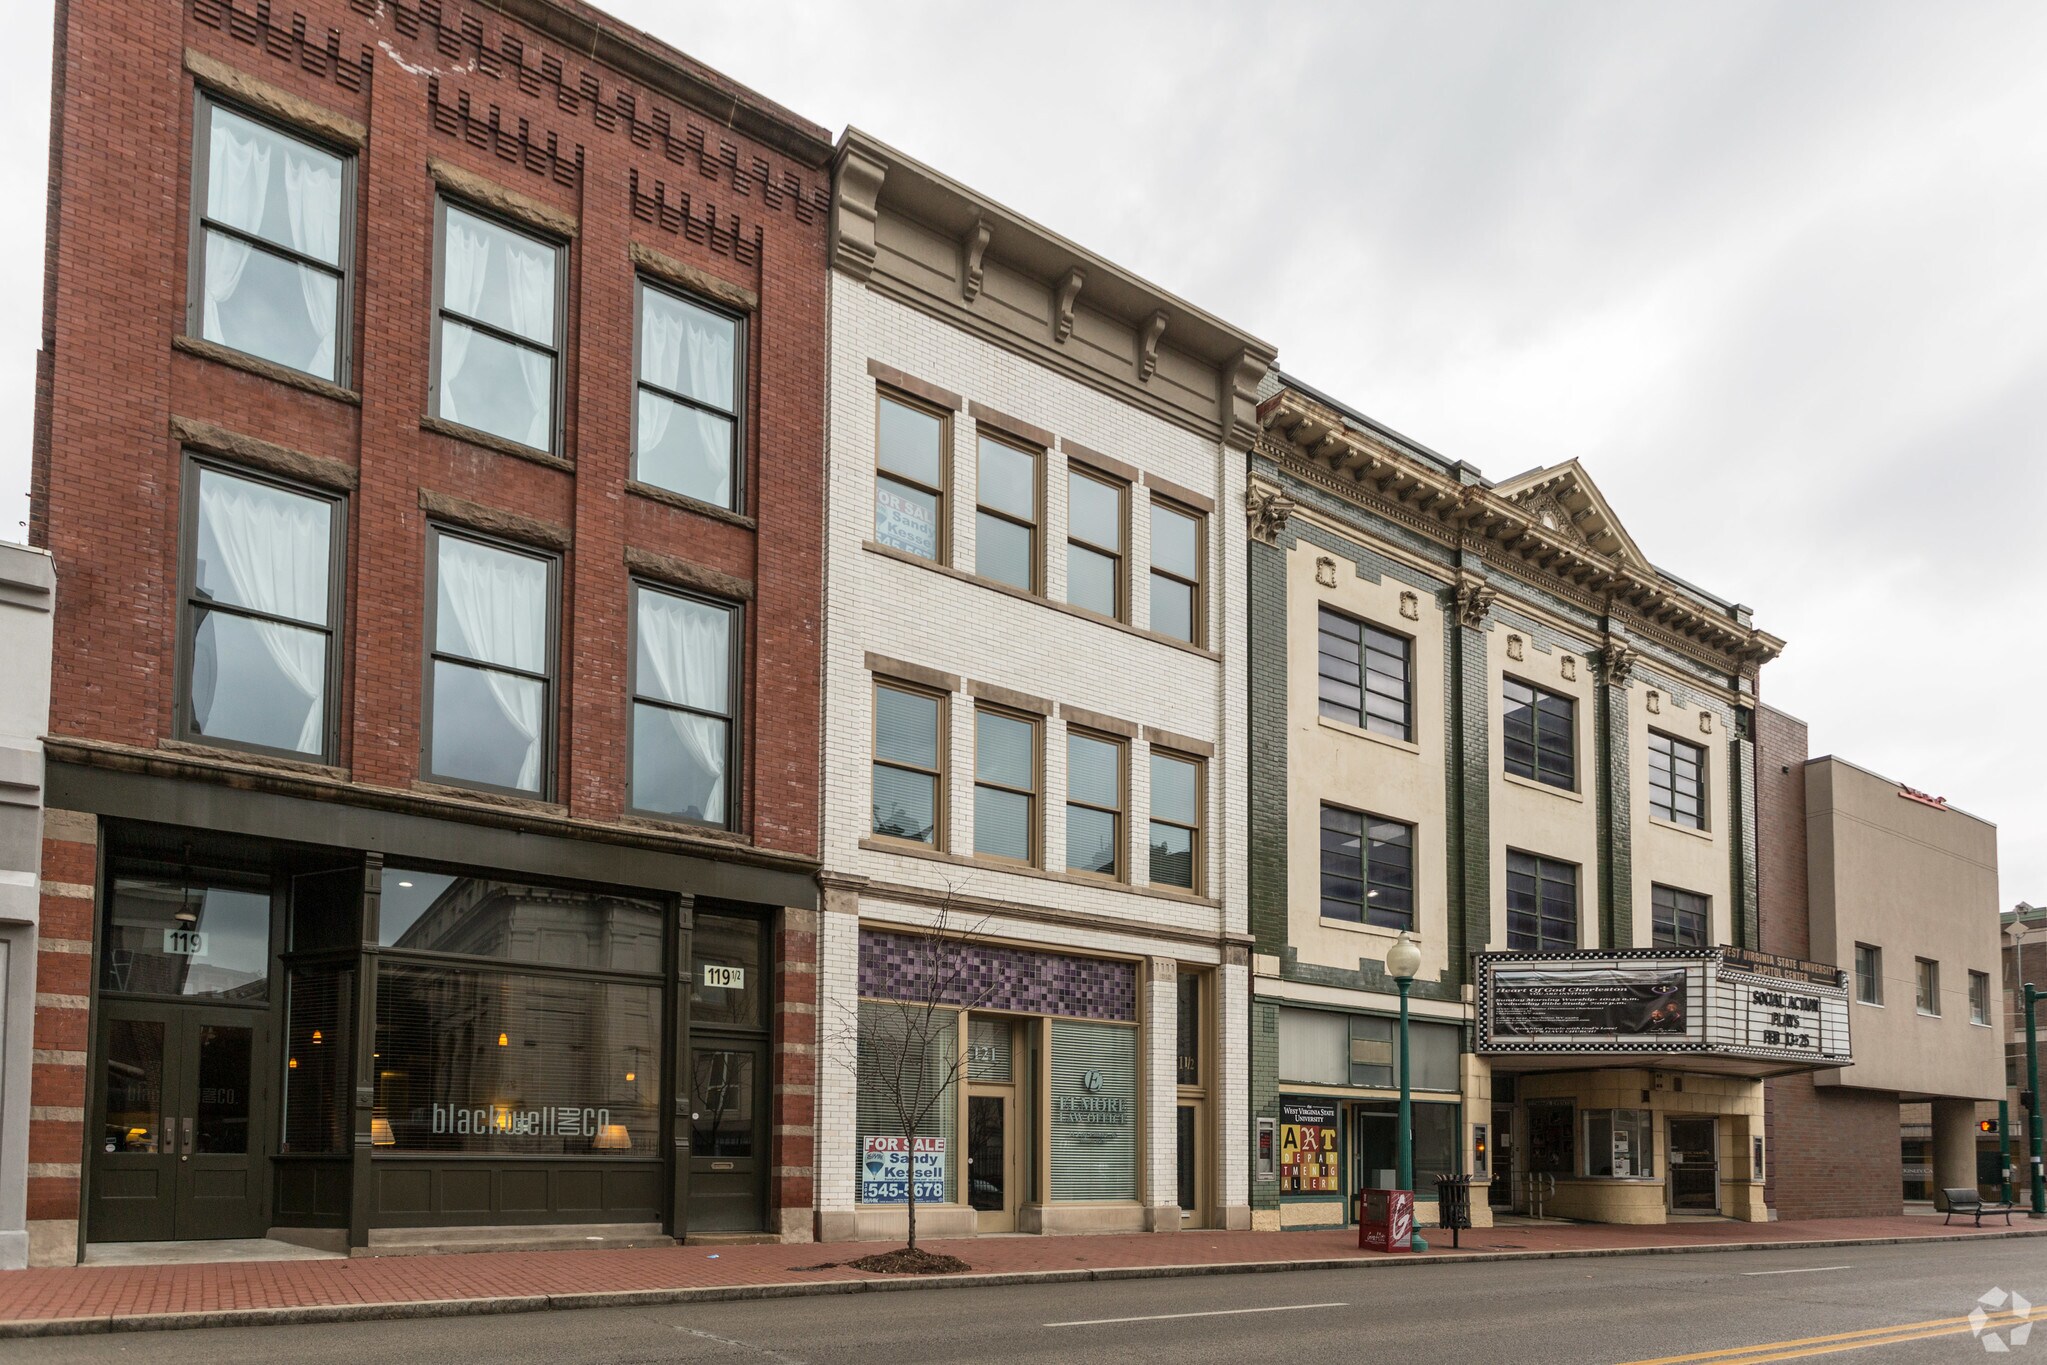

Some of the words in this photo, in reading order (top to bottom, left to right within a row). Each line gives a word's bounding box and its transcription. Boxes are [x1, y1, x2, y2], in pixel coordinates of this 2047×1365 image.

[878, 490, 900, 510] OR
[904, 502, 931, 521] SAL
[892, 511, 934, 538] Sandy
[888, 521, 931, 548] Kesse
[170, 932, 202, 953] 119
[1743, 949, 1775, 965] VIRGINIA
[1777, 956, 1797, 969] STATE
[1800, 960, 1837, 976] UNIVERSITY
[708, 967, 730, 986] 119
[1753, 963, 1783, 978] CAPITOL
[1784, 970, 1809, 982] CENTER
[1752, 990, 1785, 1008] SOCIAL
[1788, 995, 1819, 1012] ACTION
[1771, 1012, 1800, 1029] PLAYS
[1763, 1029, 1780, 1045] FEB
[973, 1046, 996, 1061] 121
[1059, 1096, 1127, 1112] ELMORE
[1283, 1106, 1299, 1115] WEST
[1299, 1107, 1321, 1116] VIRGINIA
[1320, 1109, 1335, 1117] STATE
[432, 1102, 556, 1136] blackwell
[558, 1107, 581, 1136] AND
[1059, 1111, 1083, 1122] LAW
[1295, 1115, 1324, 1123] UNIVERSITY
[865, 1137, 899, 1151] FOR
[903, 1138, 945, 1152] SALE
[1283, 1126, 1336, 1150] ART
[889, 1153, 938, 1166] Sandy
[868, 1183, 943, 1197] 545-5678
